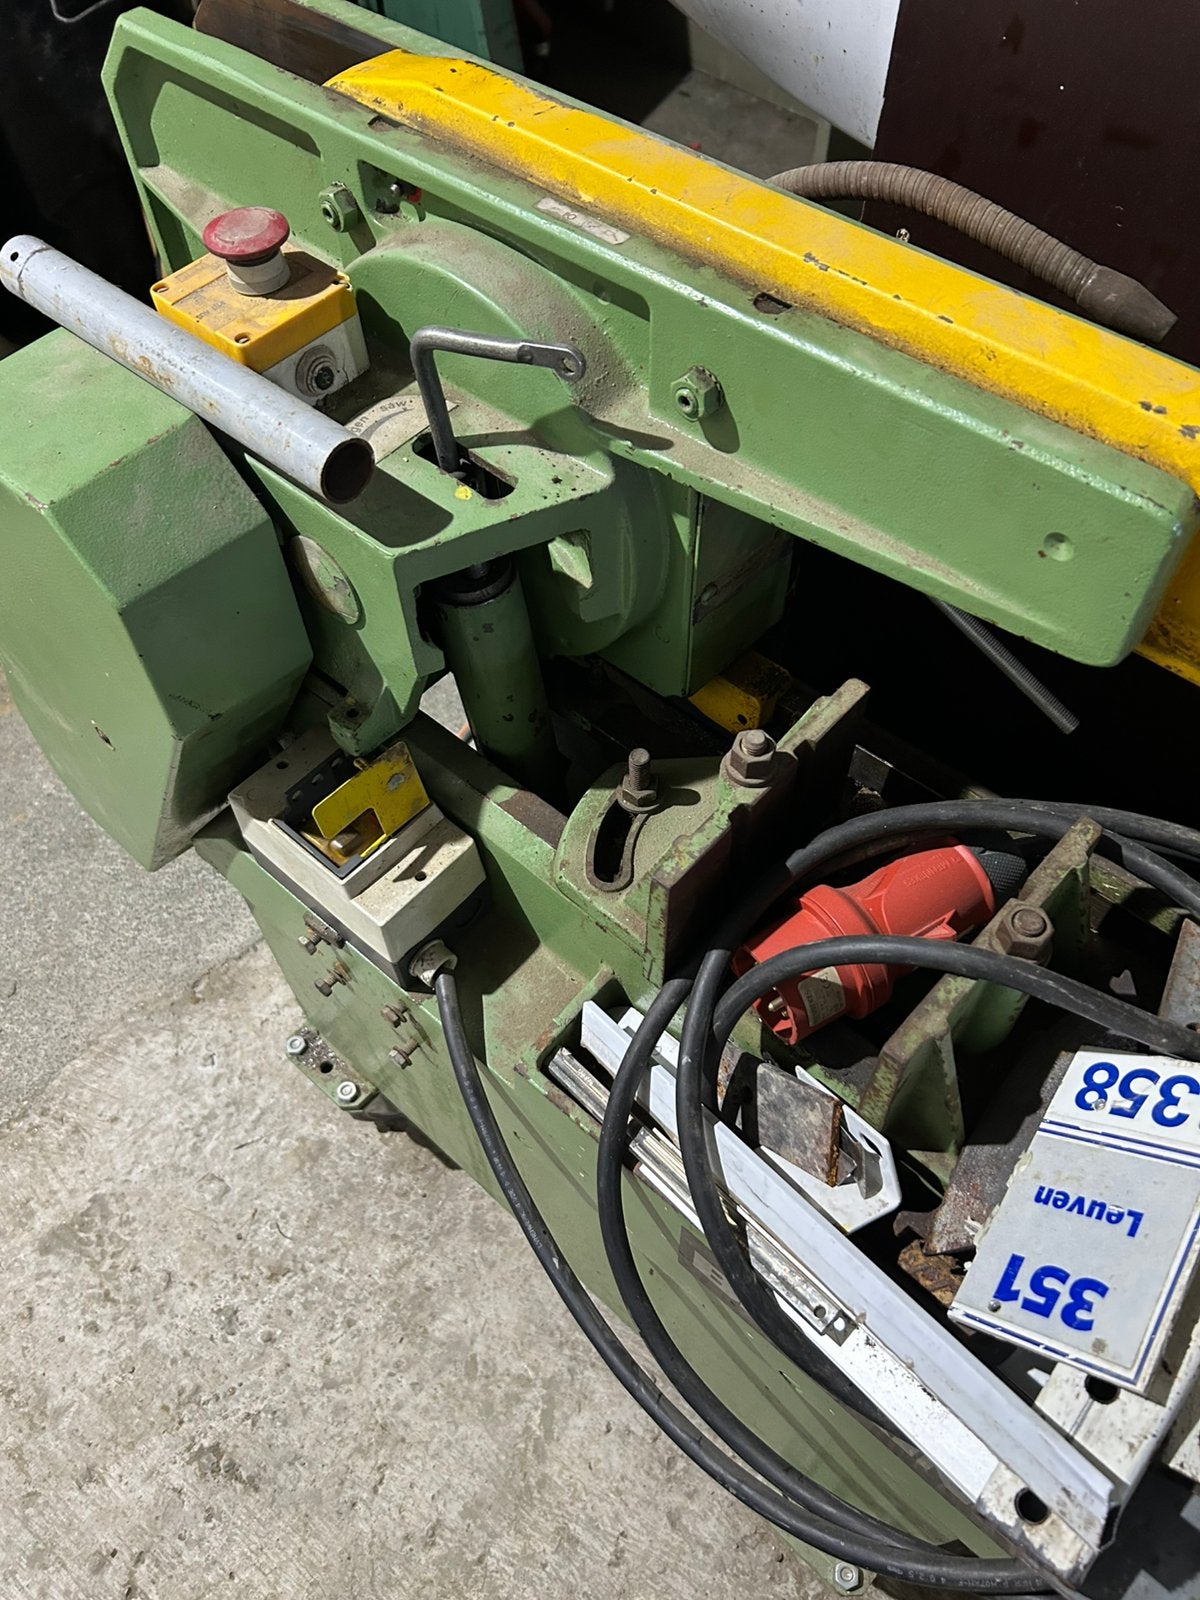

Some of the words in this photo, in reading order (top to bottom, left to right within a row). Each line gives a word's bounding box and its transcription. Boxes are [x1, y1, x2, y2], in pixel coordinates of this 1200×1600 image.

[379, 400, 407, 412] saw
[1075, 1062, 1200, 1128] 358
[1034, 1185, 1144, 1238] Leuven
[993, 1254, 1109, 1332] 351
